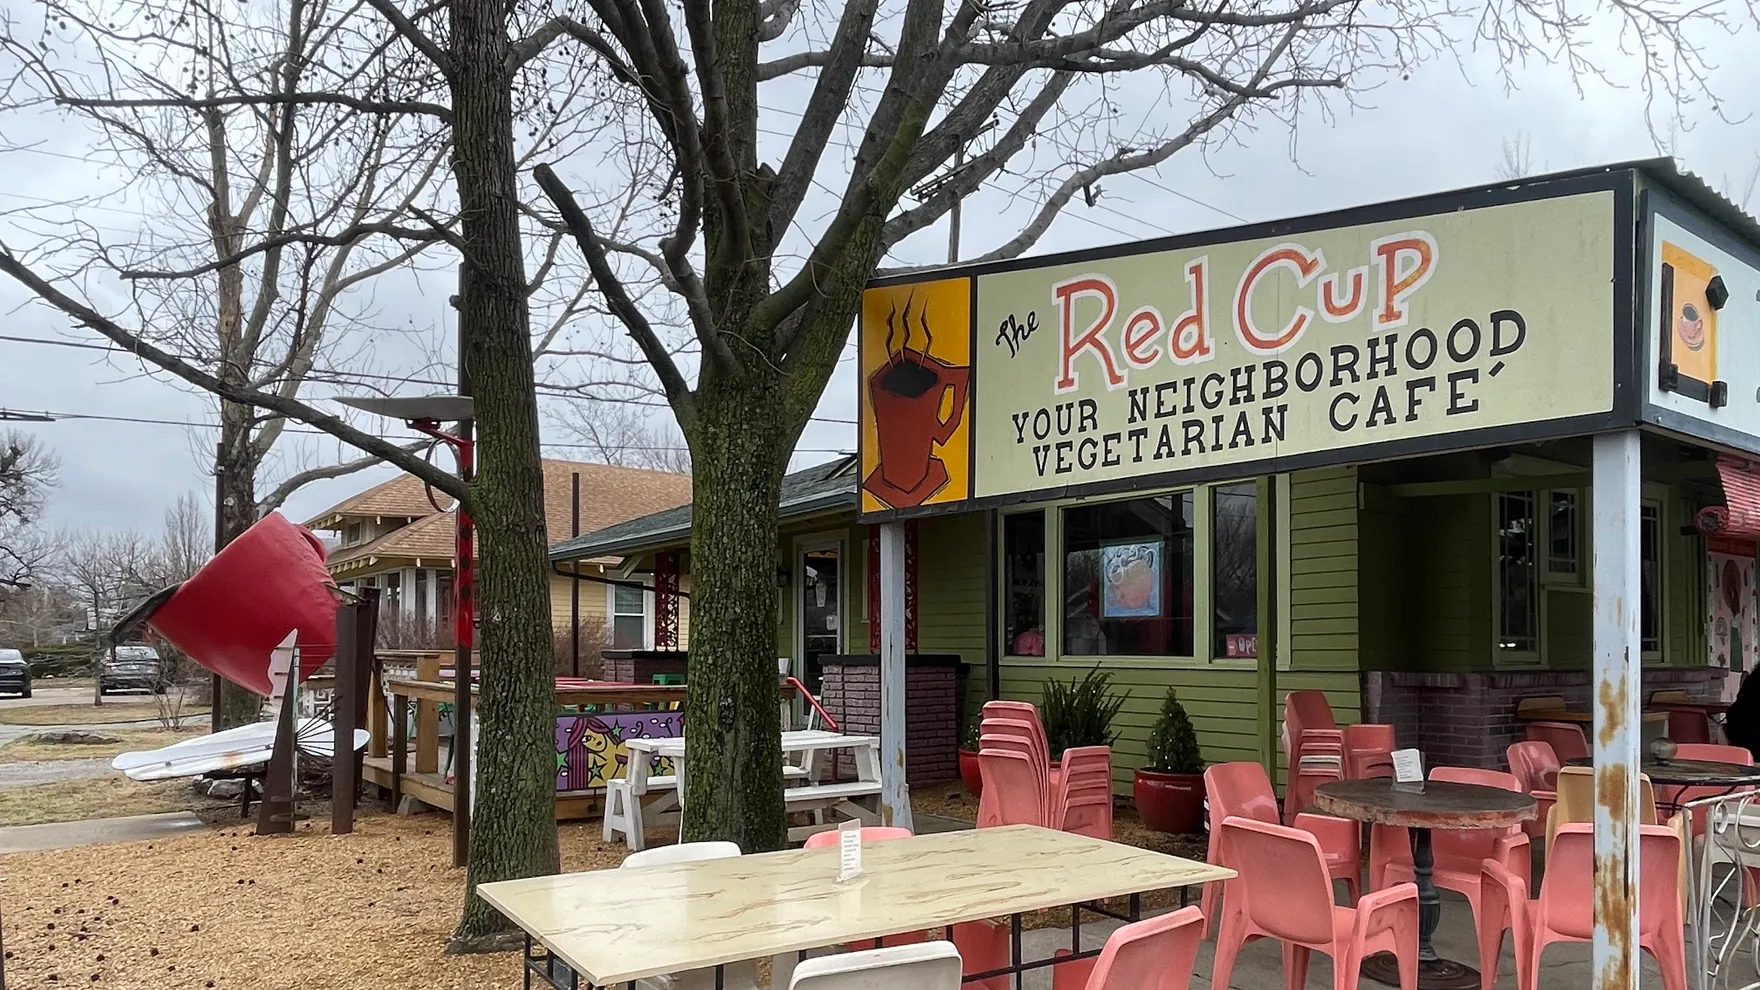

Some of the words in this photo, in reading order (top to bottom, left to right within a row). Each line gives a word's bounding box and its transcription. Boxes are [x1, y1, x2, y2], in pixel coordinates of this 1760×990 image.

[995, 310, 1040, 359] The
[1053, 257, 1214, 394] Red
[1012, 399, 1098, 444] YOUR
[1128, 309, 1526, 424] NEIGHBORHOOD
[1033, 404, 1288, 476] VEGETARIAN
